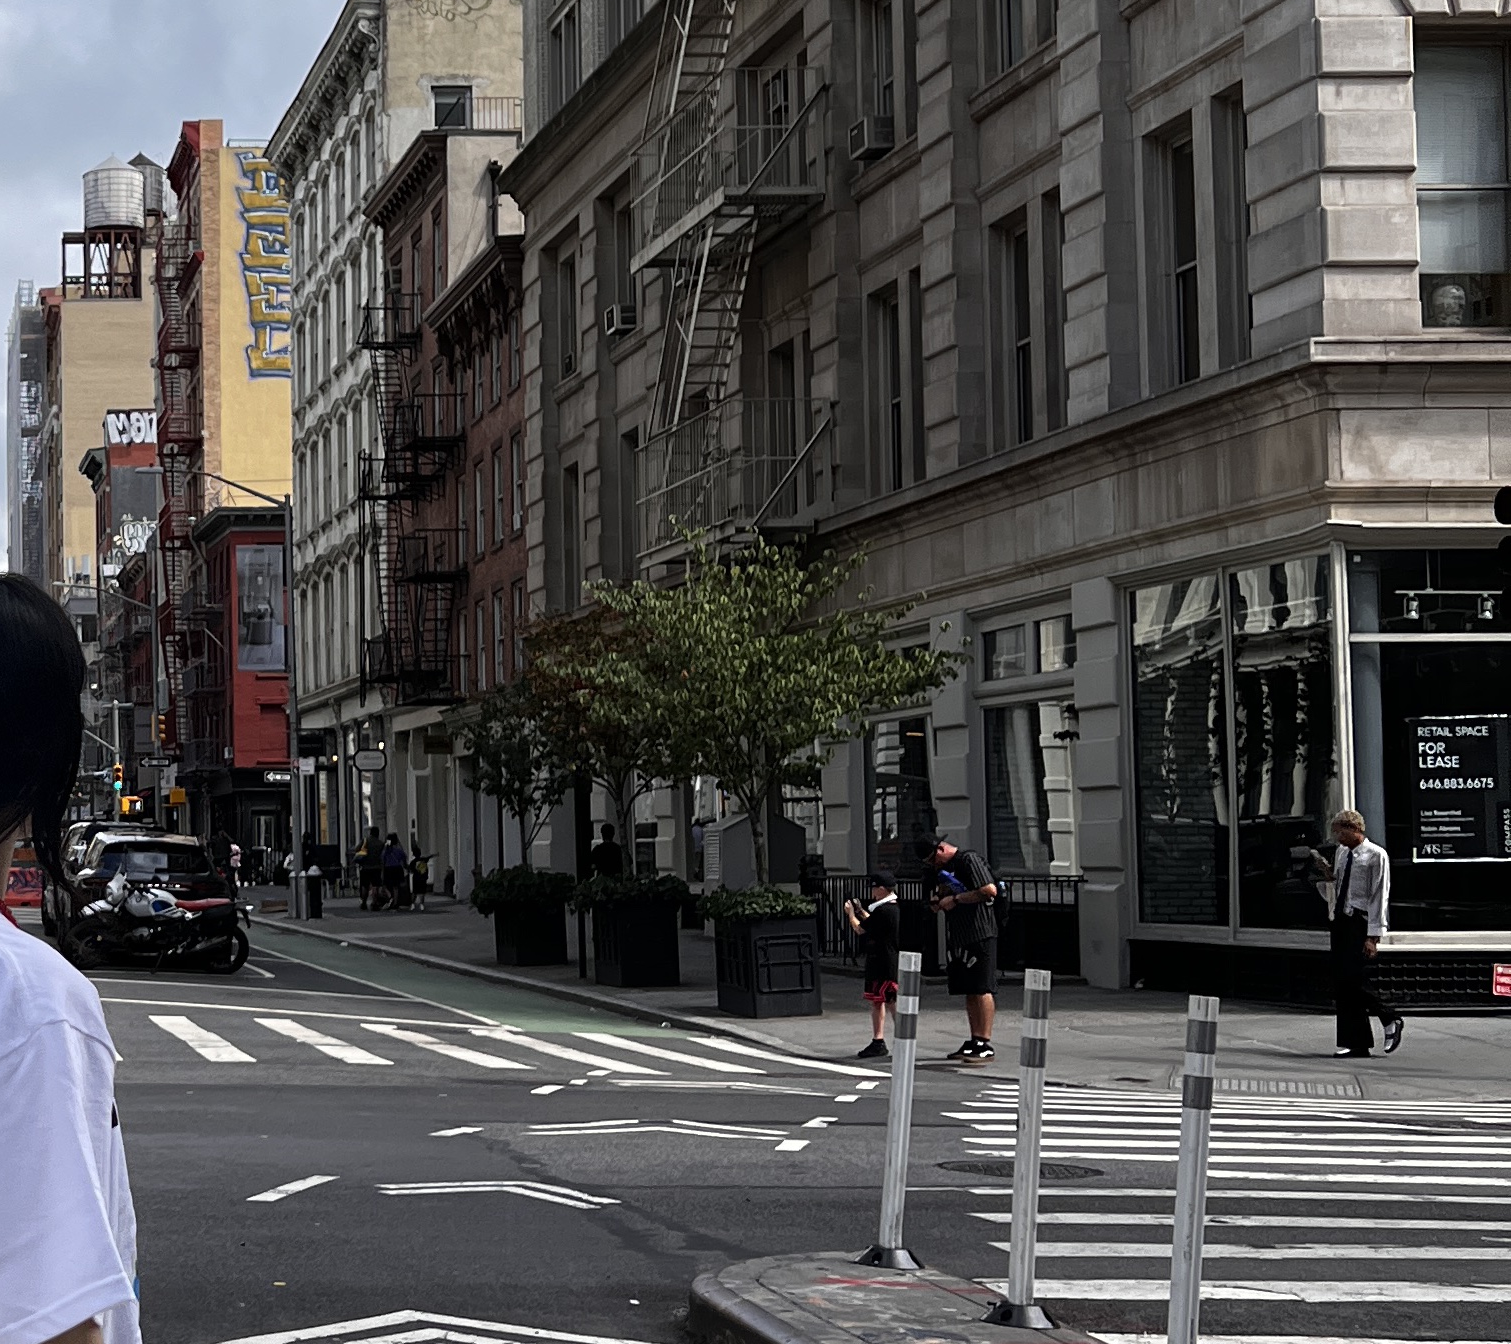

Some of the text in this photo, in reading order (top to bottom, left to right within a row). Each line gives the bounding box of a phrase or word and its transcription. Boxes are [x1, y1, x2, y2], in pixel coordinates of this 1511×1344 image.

[1417, 725, 1489, 737] RETAIL SPACE
[1418, 742, 1446, 754] FOR
[1418, 756, 1460, 768] LEASE
